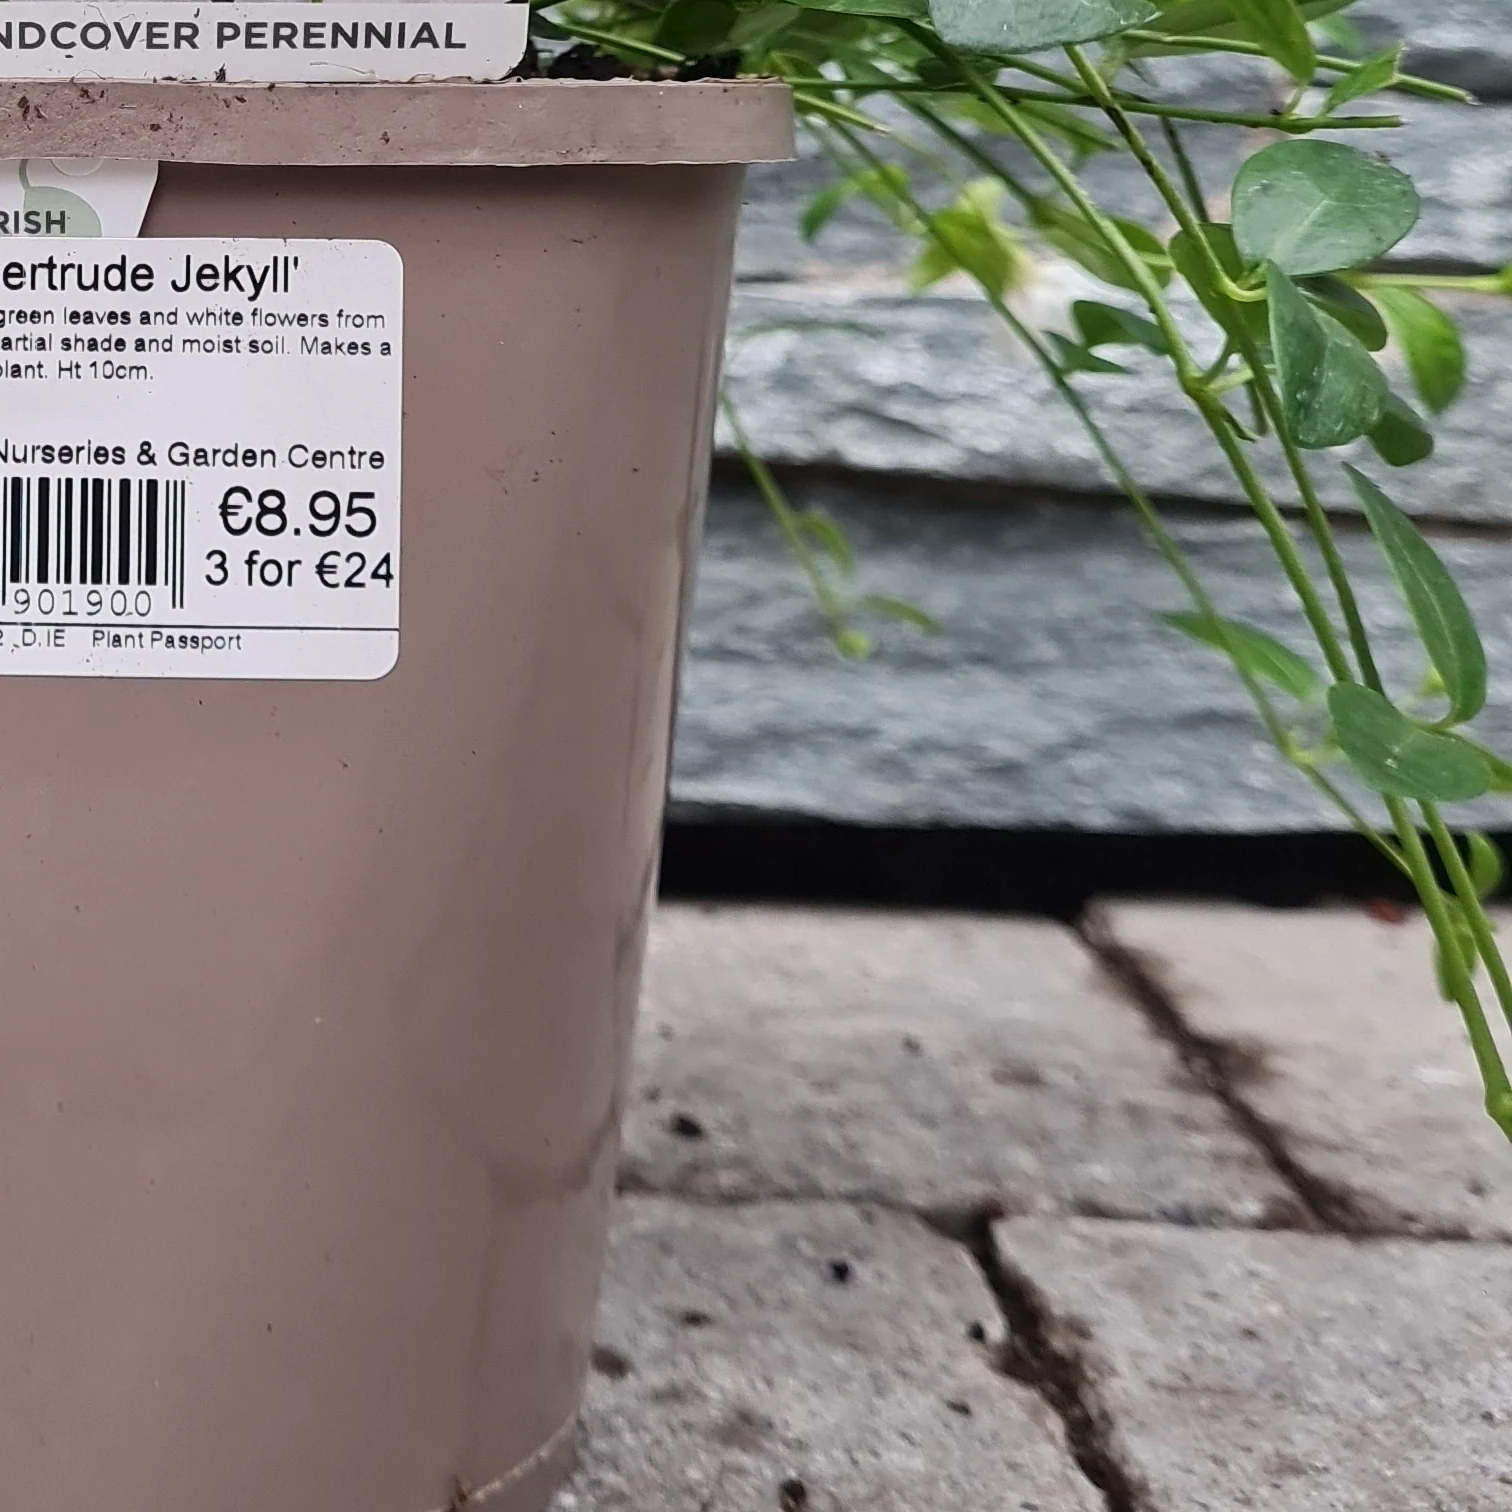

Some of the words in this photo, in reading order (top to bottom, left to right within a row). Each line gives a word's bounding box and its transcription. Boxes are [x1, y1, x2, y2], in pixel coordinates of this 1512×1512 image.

[215, 17, 468, 52] PERENNIAL
[169, 254, 301, 300] Jekyll'
[61, 305, 132, 326] leaves
[138, 306, 179, 327] and
[186, 305, 244, 328] white
[250, 306, 330, 329] flowers
[335, 307, 386, 330] from
[59, 332, 128, 354] shade
[133, 333, 174, 354] and
[180, 333, 243, 355] moist
[247, 335, 292, 356] soil.
[299, 335, 373, 357] Makes
[378, 338, 393, 357] a
[56, 359, 83, 381] Ht
[88, 359, 155, 382] 10cm.
[136, 440, 158, 467] &
[167, 440, 278, 469] Garden
[287, 443, 386, 471] Centre
[217, 485, 379, 538] €8.95
[204, 549, 230, 588] 3
[243, 549, 303, 589] for
[315, 550, 396, 590] €24
[92, 629, 146, 650] Plant
[149, 631, 243, 655] Passport
